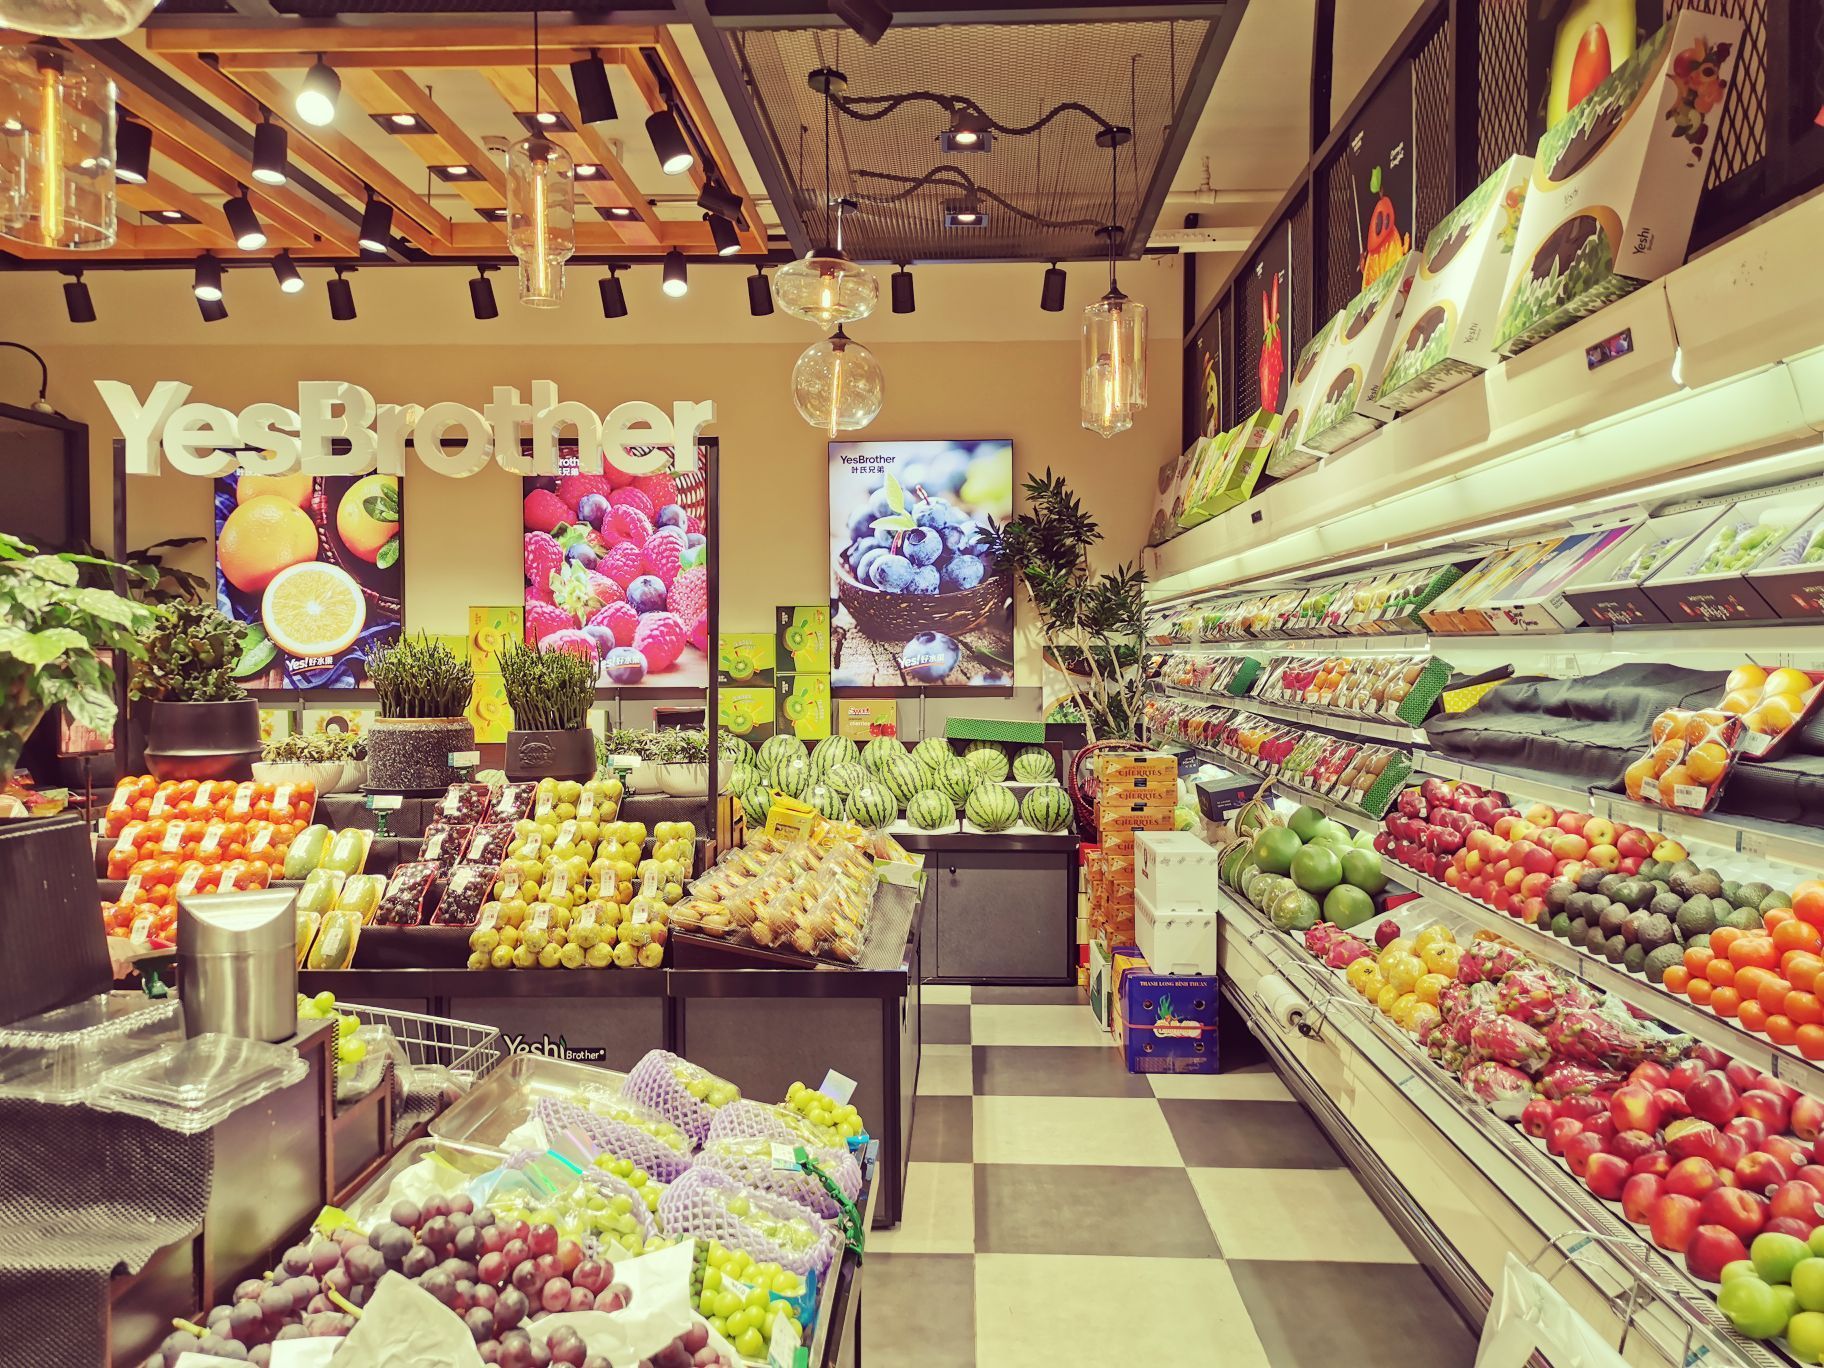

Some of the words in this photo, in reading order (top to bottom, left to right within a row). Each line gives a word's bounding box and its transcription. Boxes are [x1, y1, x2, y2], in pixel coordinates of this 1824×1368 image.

[1632, 227, 1651, 255] Yeshi
[1464, 323, 1479, 344] Yeshi
[93, 379, 717, 478] YesBrother
[840, 454, 896, 465] YesBrother
[851, 465, 885, 474] 叶氏兄弟
[285, 656, 309, 671] Yes!
[896, 654, 920, 669] Yes!
[1118, 769, 1162, 777] CHERRIES
[1118, 792, 1163, 800] CHERRIES
[1115, 818, 1159, 826] CHERRIES
[503, 1034, 566, 1060] Yeshi
[566, 1050, 600, 1060] Brother
